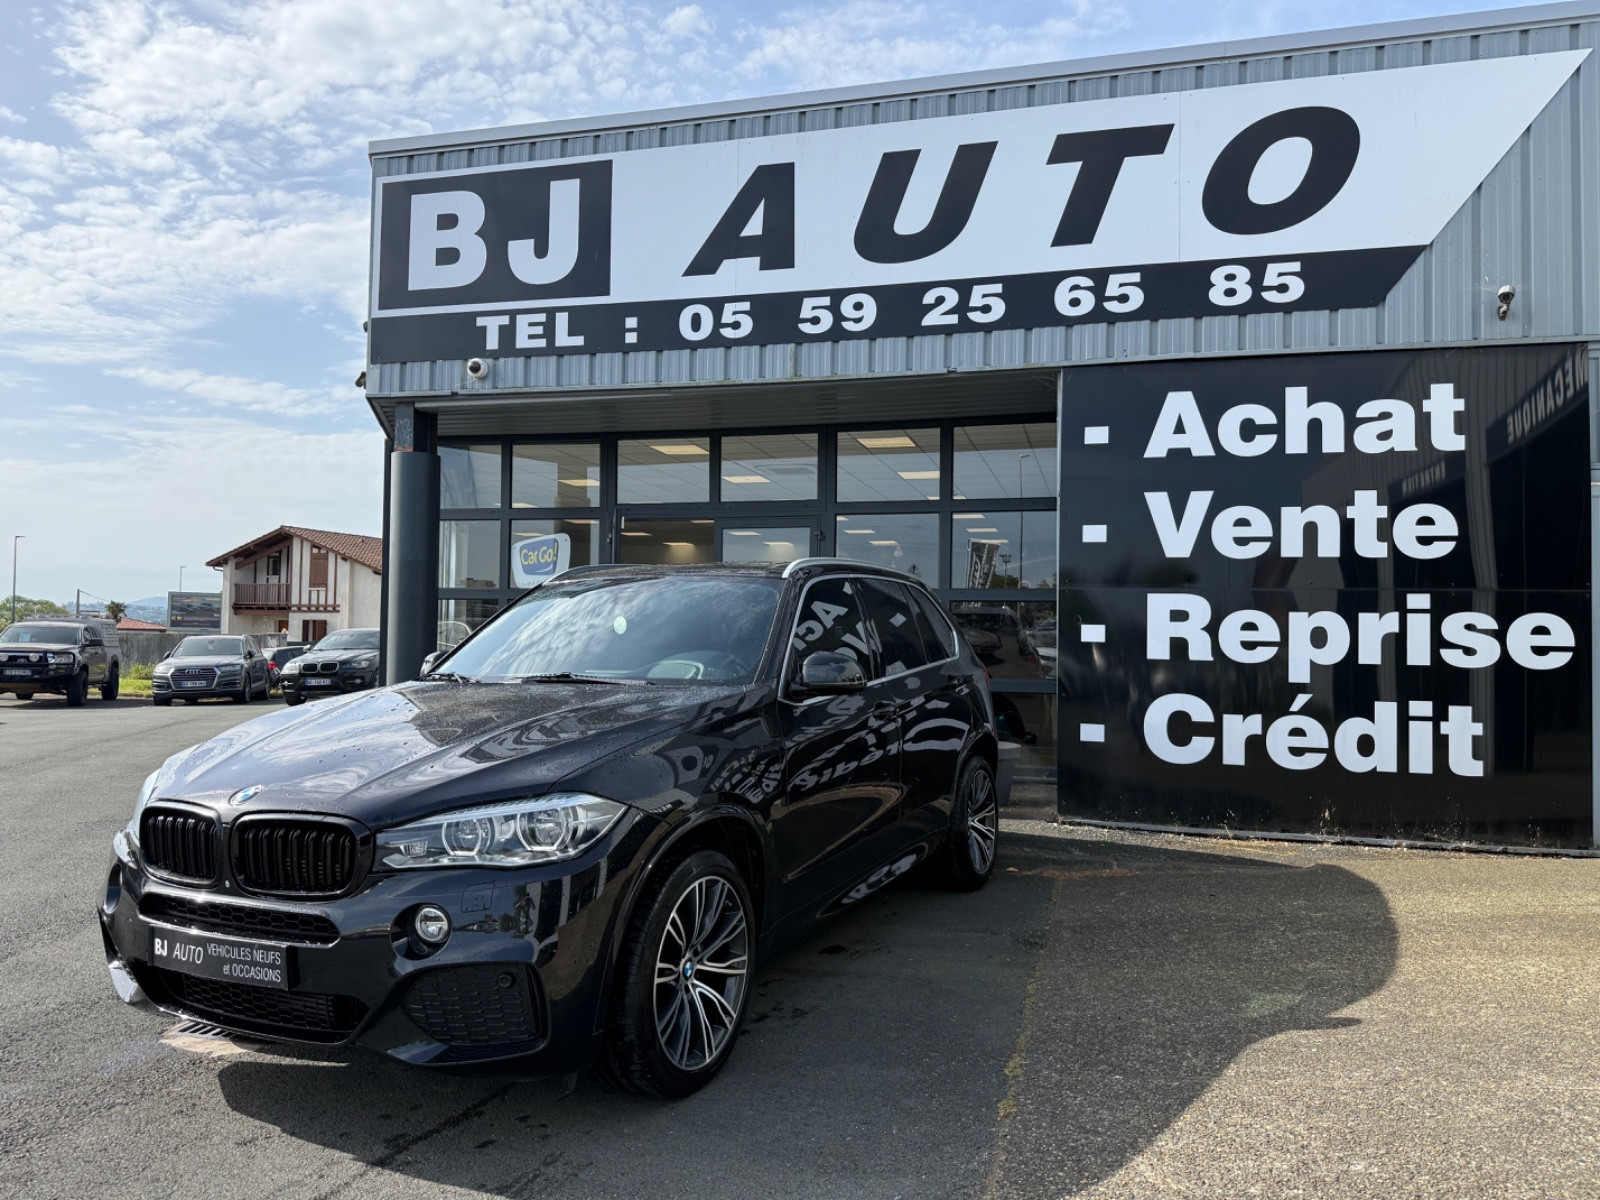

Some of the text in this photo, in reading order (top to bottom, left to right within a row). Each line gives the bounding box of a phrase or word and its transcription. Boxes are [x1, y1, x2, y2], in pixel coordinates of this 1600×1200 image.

[408, 106, 1360, 291] BJ AUTO
[476, 312, 584, 350] TEL
[679, 302, 753, 340] 05
[798, 294, 876, 334] 59
[918, 284, 1005, 326] 25
[1054, 272, 1144, 316] 65
[1208, 262, 1304, 306] 85
[1144, 383, 1465, 458] Achat
[1144, 490, 1458, 559] Vente
[1147, 593, 1575, 683] Reprise
[1144, 693, 1483, 776] Crédit
[154, 938, 204, 964] BJ AUTO
[206, 942, 281, 965] VEHICULES NEUFS
[223, 963, 281, 982] et OCCASIONS
